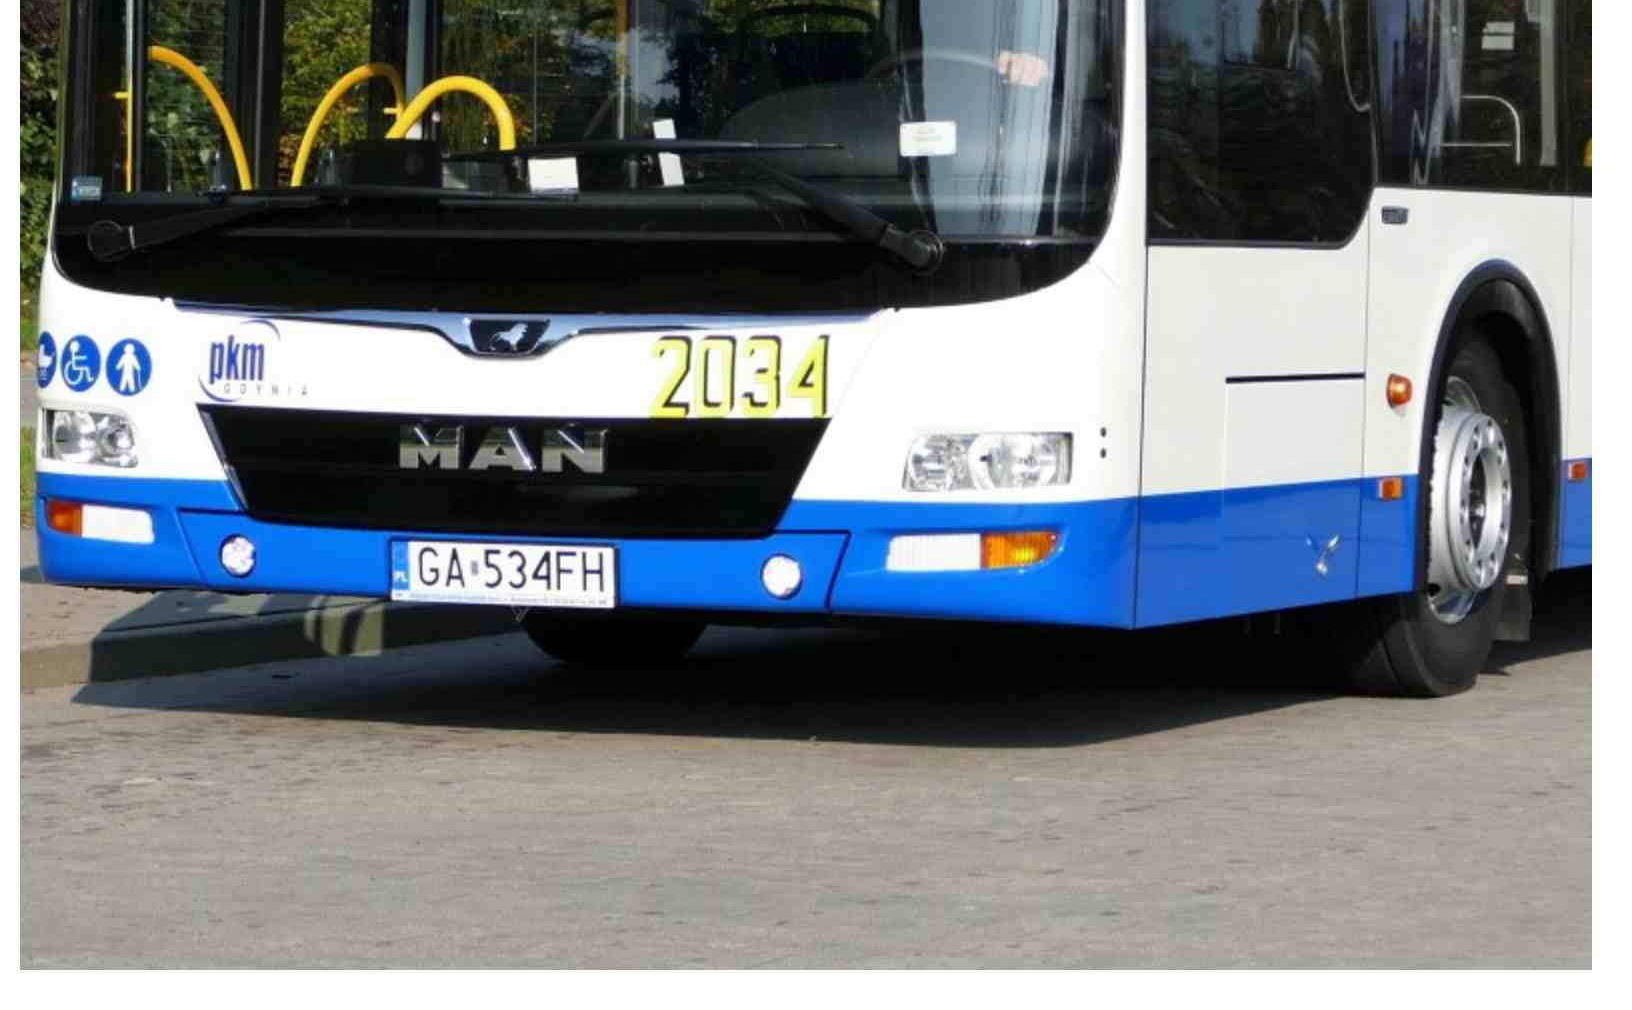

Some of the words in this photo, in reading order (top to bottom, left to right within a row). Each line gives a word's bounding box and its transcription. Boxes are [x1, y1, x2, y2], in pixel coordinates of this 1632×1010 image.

[209, 334, 265, 385] pkm
[648, 335, 830, 419] 2034
[223, 382, 309, 396] GDYNIA
[399, 424, 609, 474] MAN
[419, 547, 465, 588] GA
[484, 549, 604, 592] 534FH
